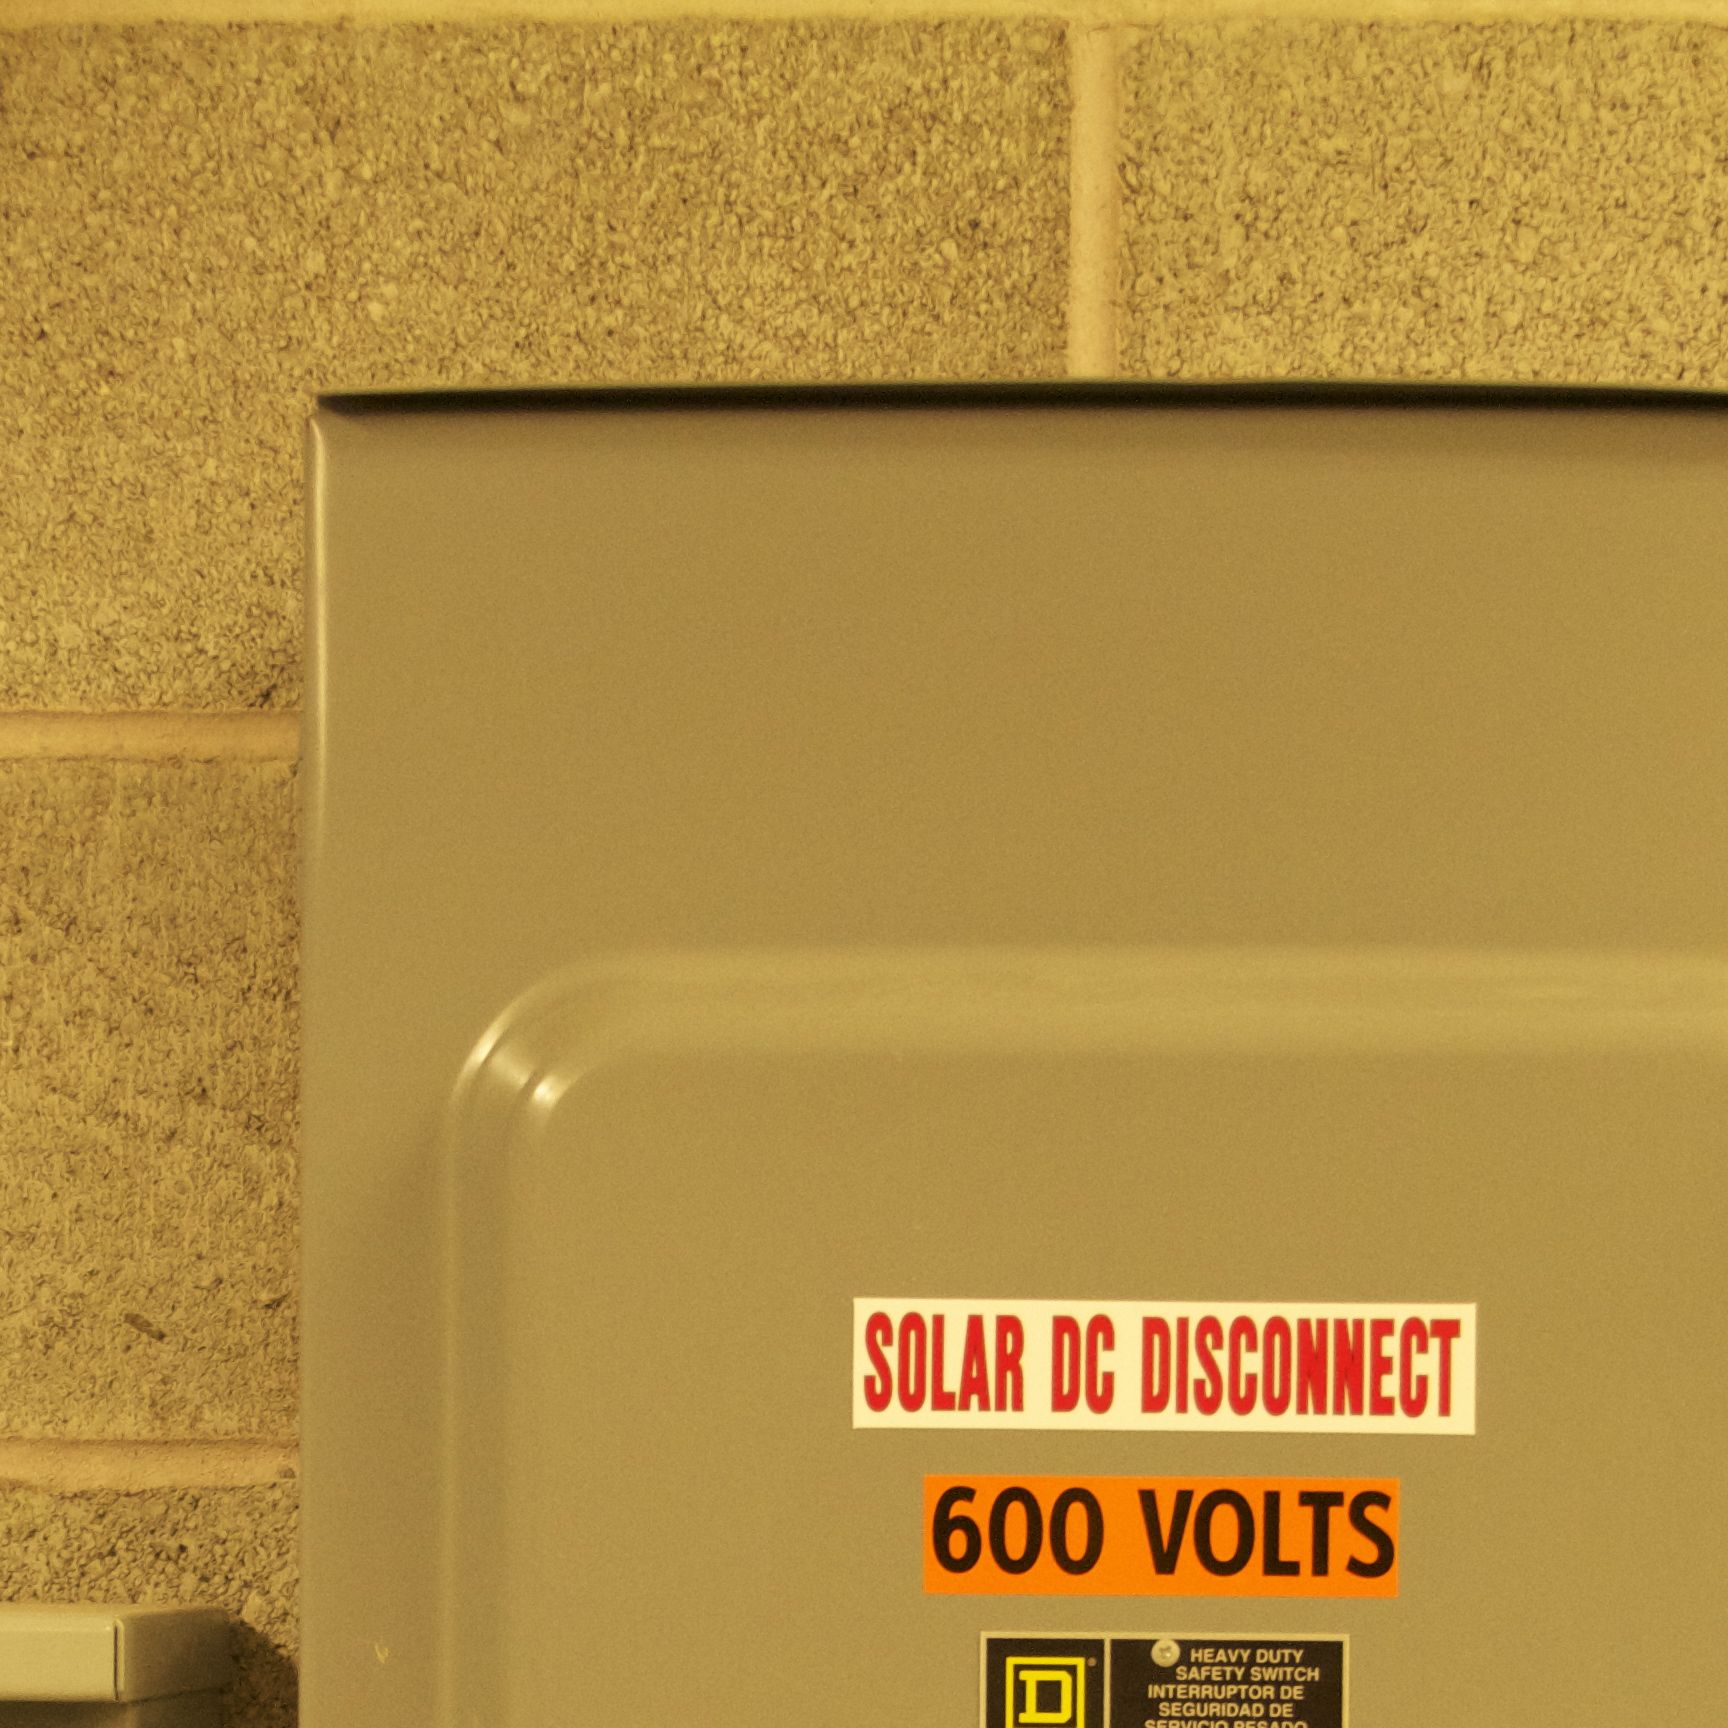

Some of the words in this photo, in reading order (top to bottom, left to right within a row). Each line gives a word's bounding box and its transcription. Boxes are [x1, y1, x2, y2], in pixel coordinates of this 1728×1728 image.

[864, 1312, 1024, 1412] SOLAR
[1051, 1314, 1115, 1414] DC
[1141, 1315, 1461, 1418] DISCONNECT
[932, 1486, 1104, 1576] 600
[1138, 1488, 1395, 1579] VOLTS
[1190, 1648, 1251, 1663] HEAVY
[1256, 1649, 1304, 1664] DUTY
[1176, 1665, 1245, 1681] SAFETY
[1250, 1666, 1320, 1682] SWITCH
[1148, 1684, 1275, 1700] INTERRUPTOR
[1280, 1685, 1304, 1700] DE
[1159, 1702, 1264, 1717] SEGURIDAD
[1269, 1703, 1293, 1718] DE
